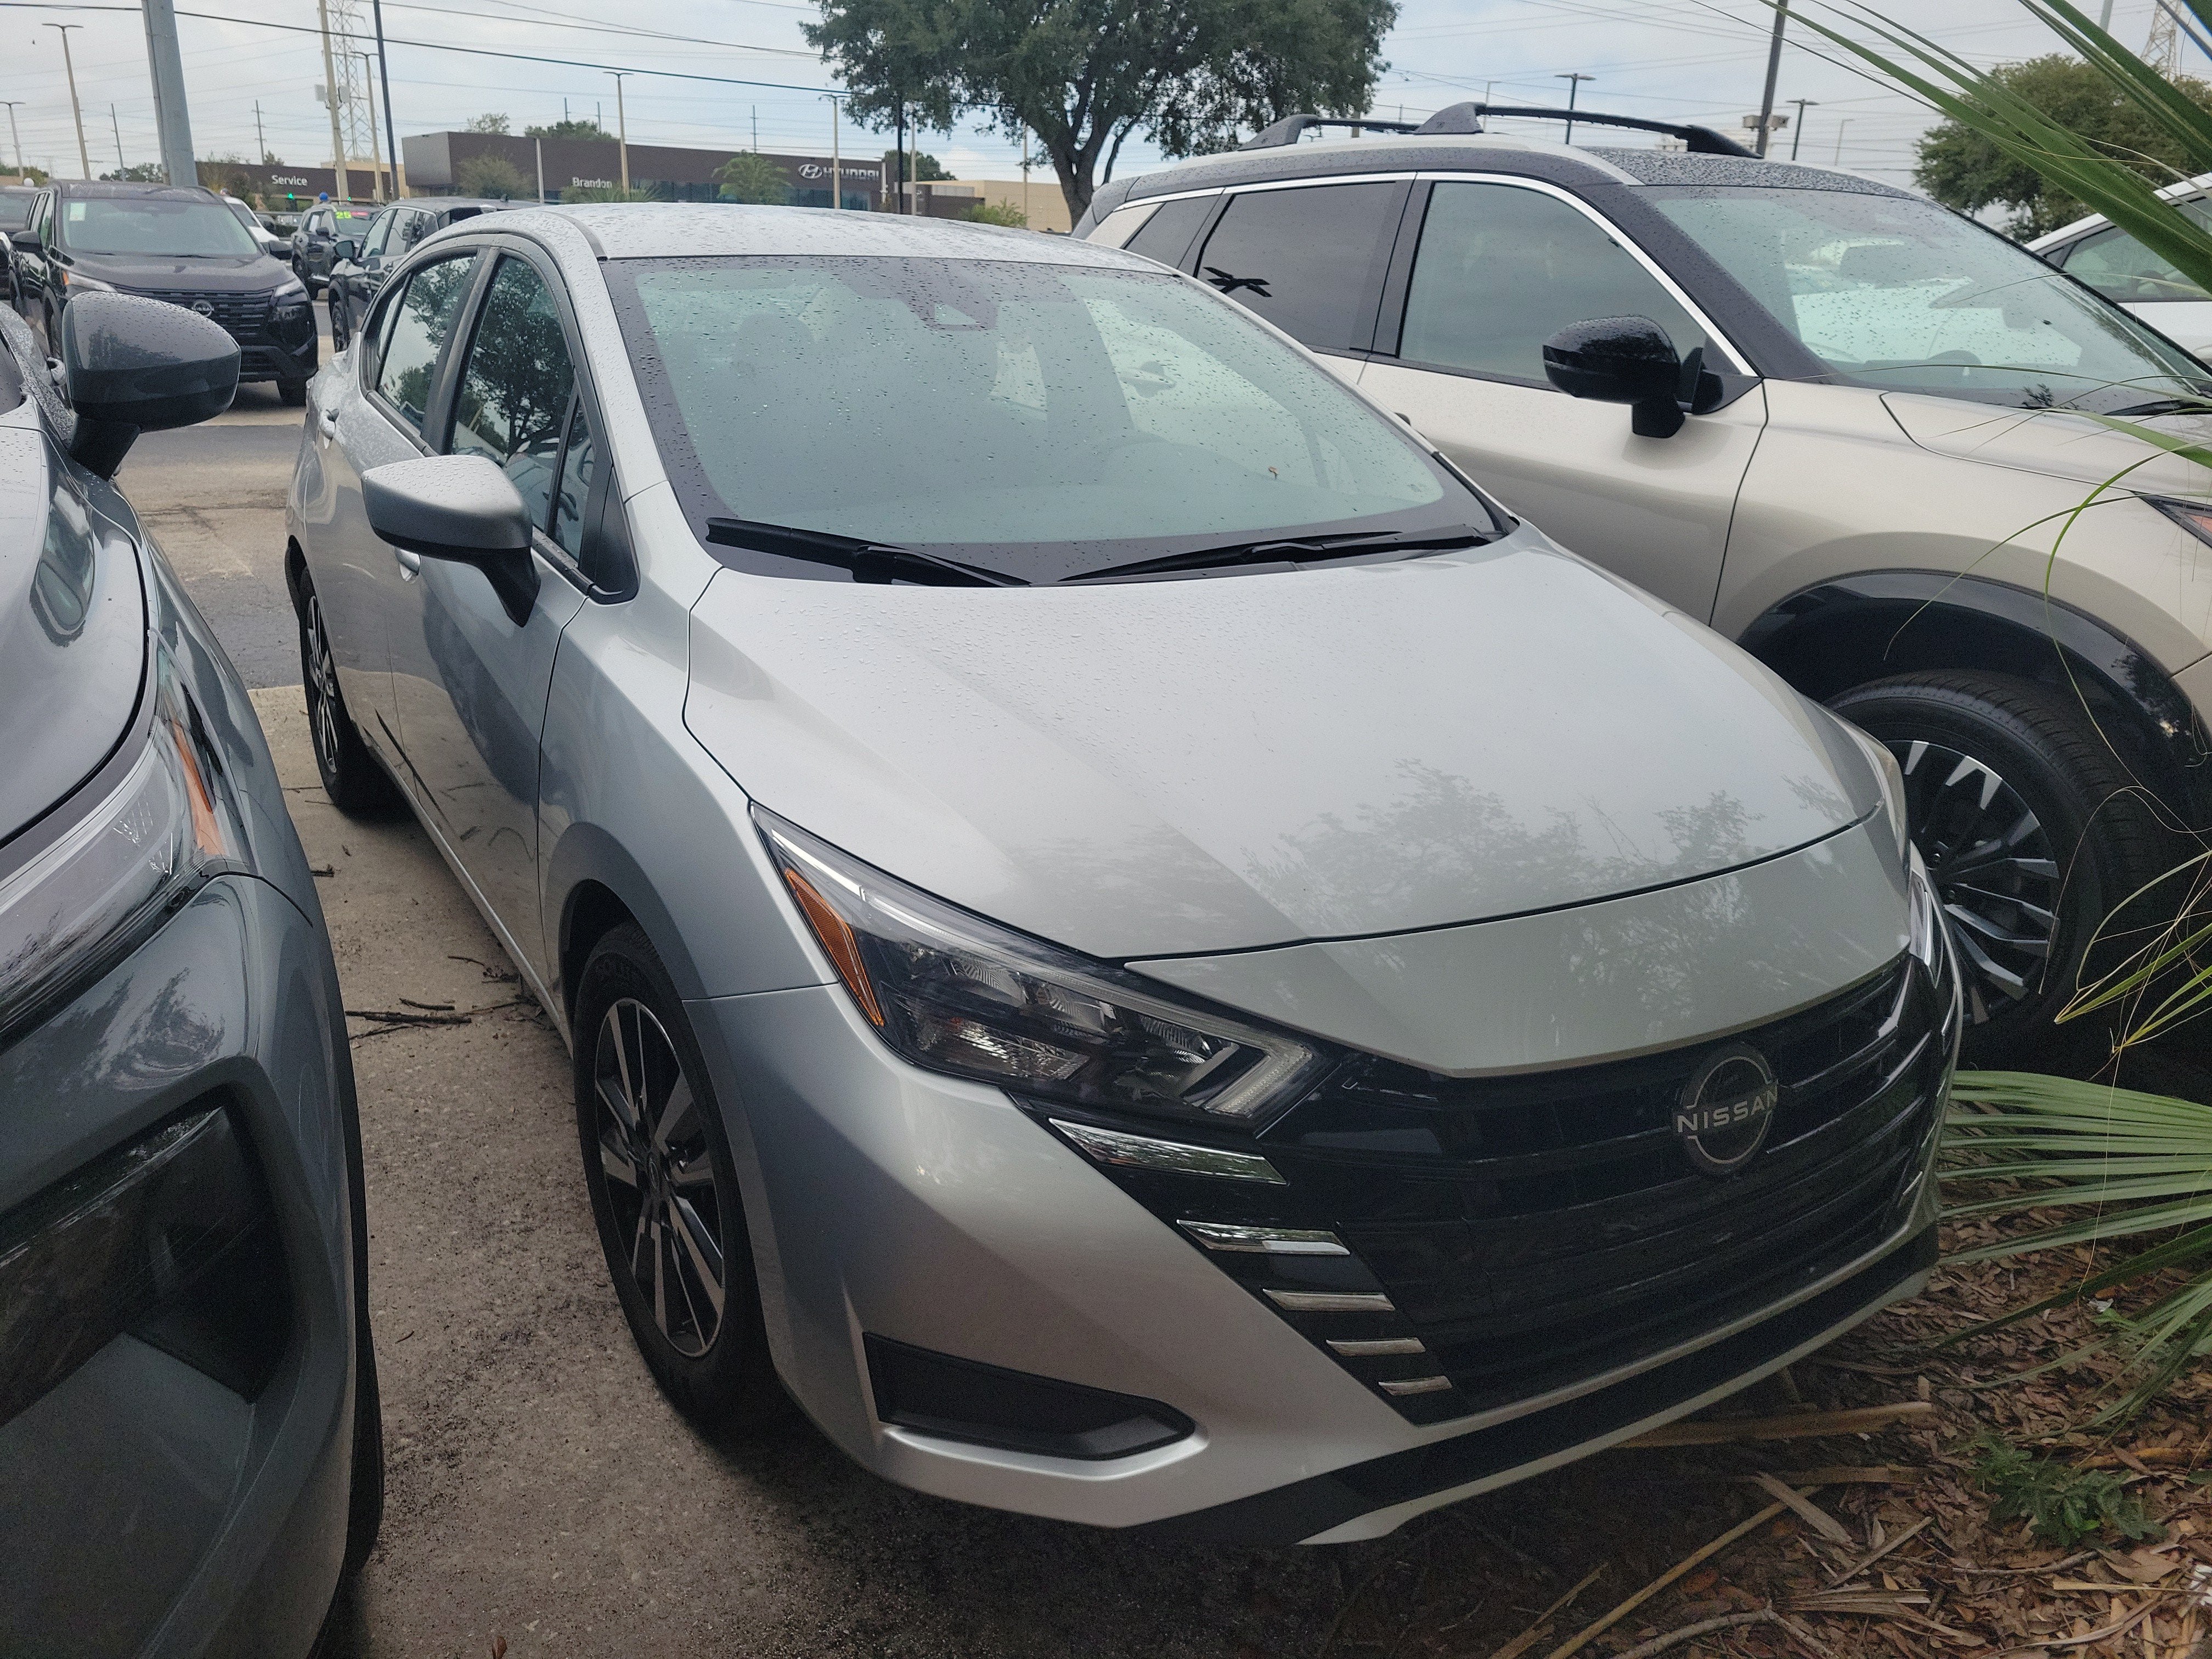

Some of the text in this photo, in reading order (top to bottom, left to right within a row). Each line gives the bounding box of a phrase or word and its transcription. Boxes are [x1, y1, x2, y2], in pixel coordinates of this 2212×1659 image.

[822, 166, 879, 180] HUNDAI
[272, 174, 308, 186] Service
[572, 177, 613, 188] Brandon
[1677, 1086, 1778, 1133] NISSAN
